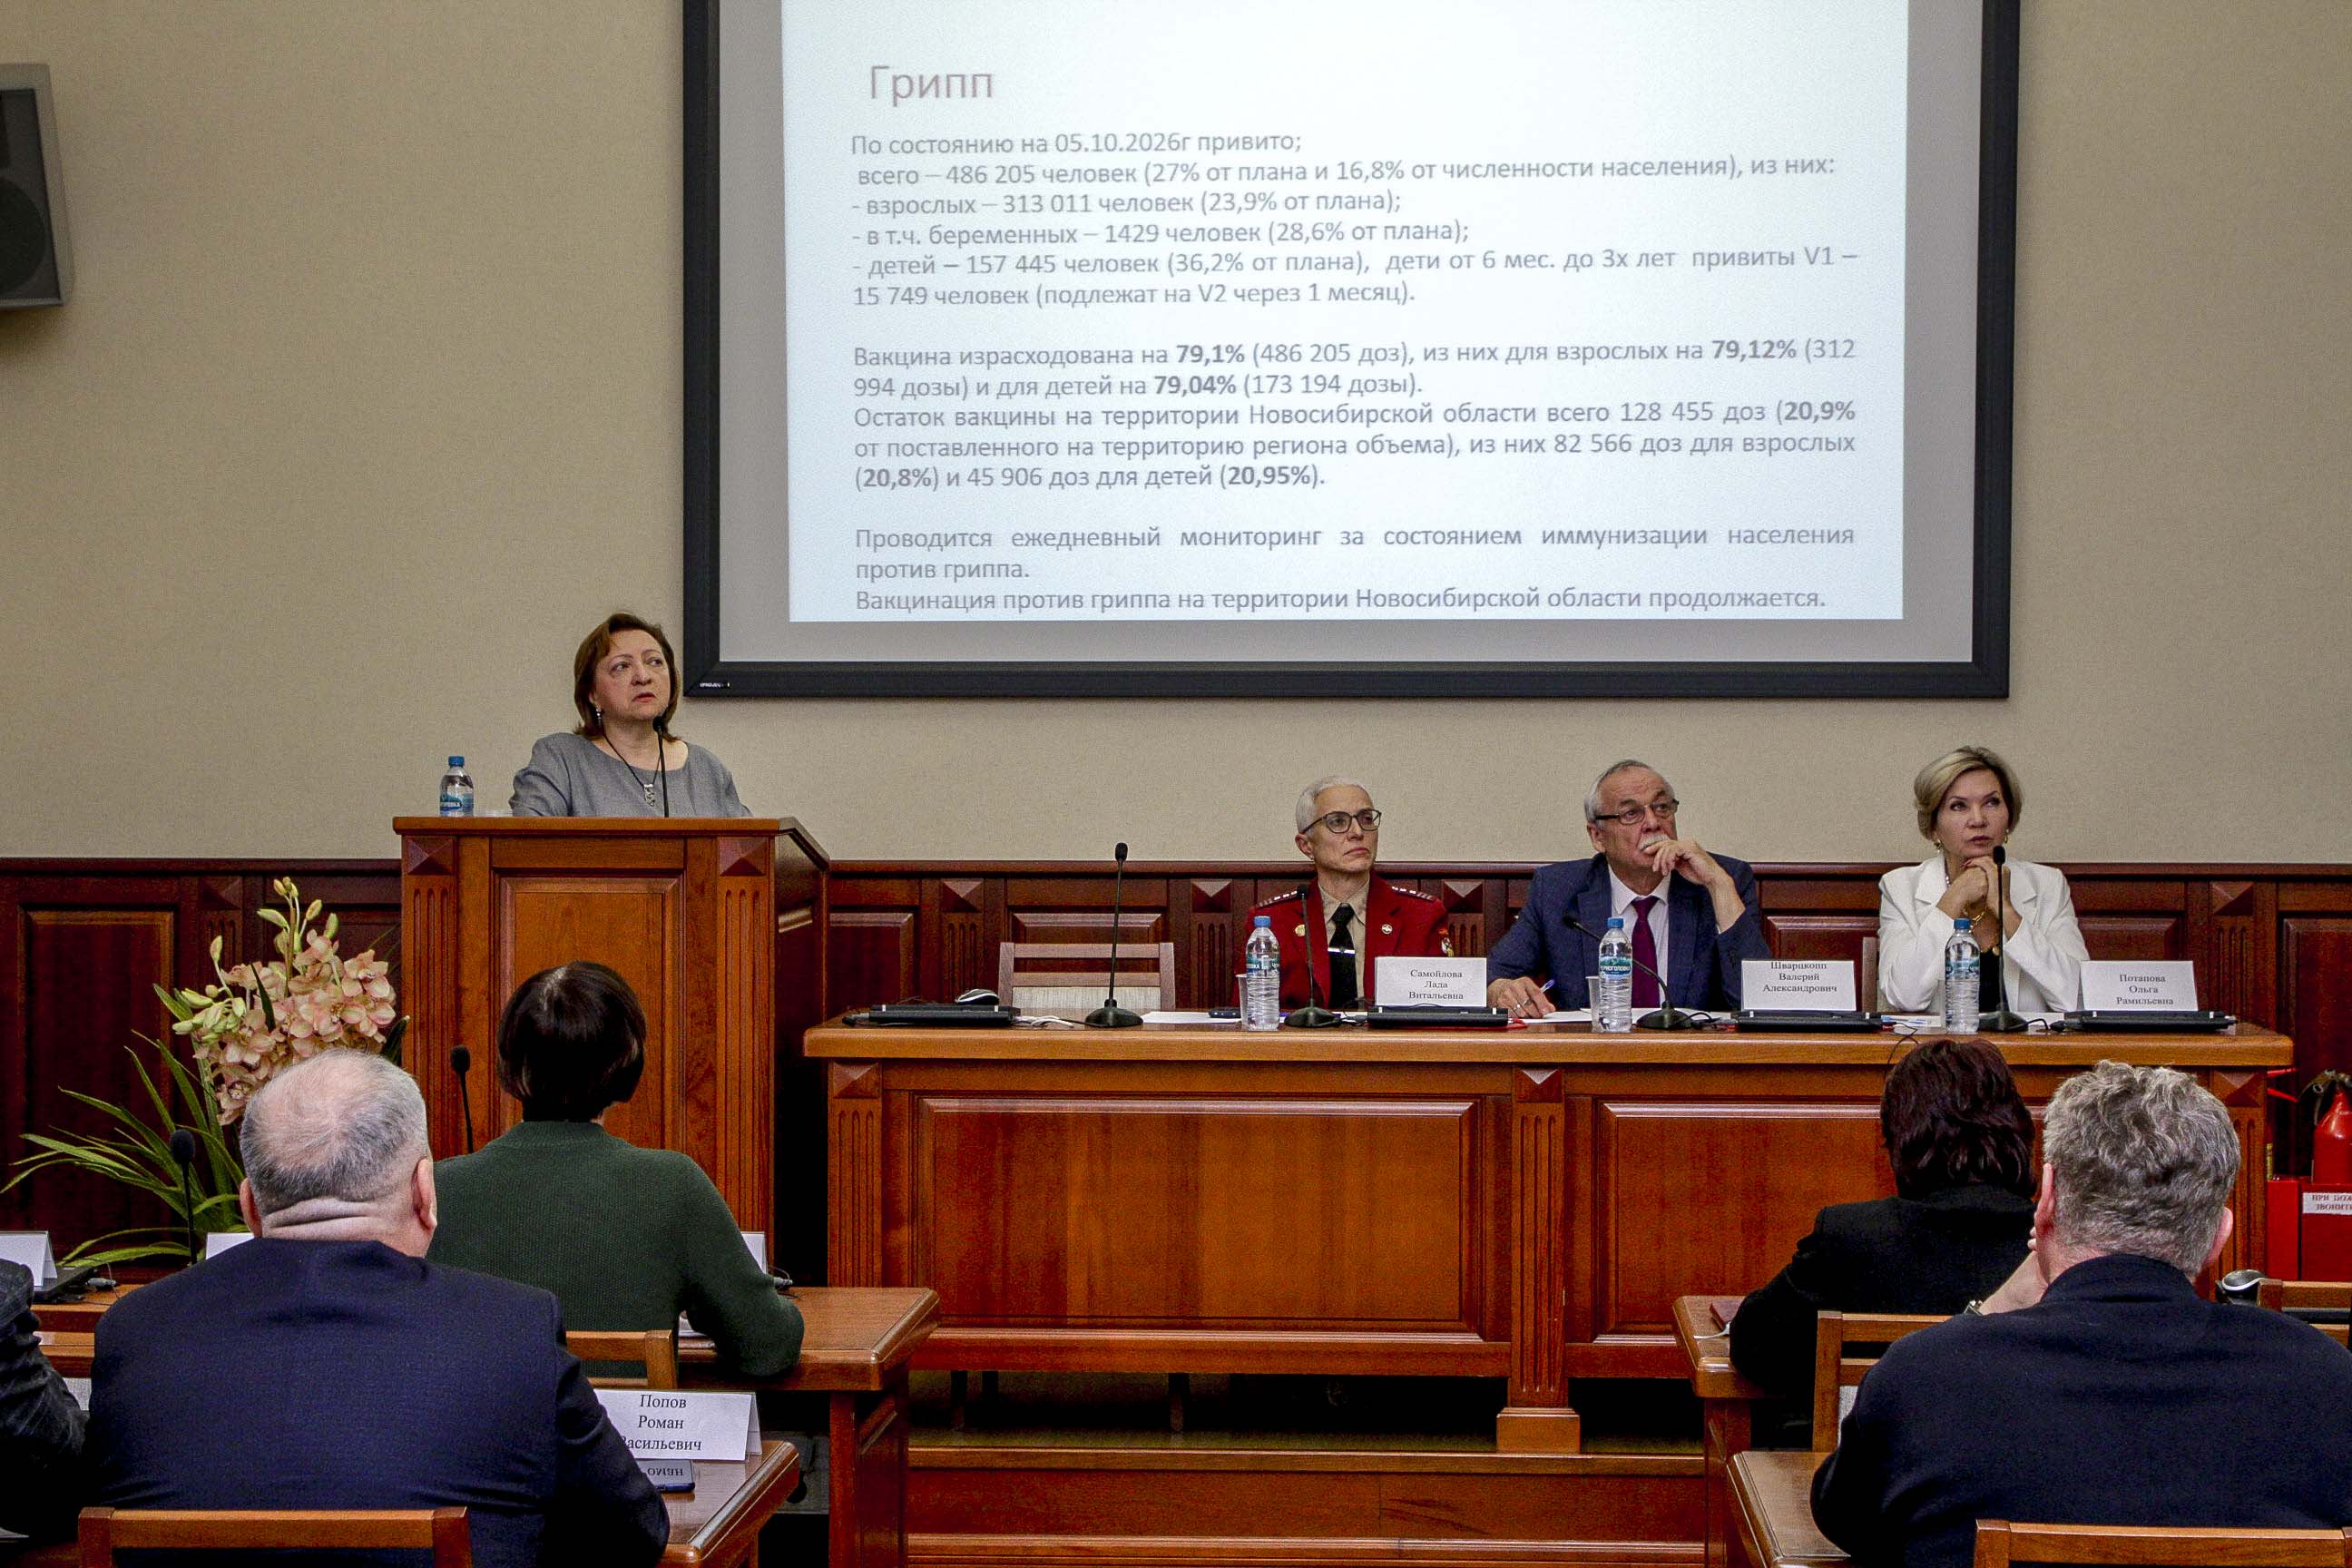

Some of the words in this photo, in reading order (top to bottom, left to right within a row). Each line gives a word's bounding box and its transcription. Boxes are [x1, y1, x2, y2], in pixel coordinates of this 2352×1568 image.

[870, 64, 993, 108] Грипп
[851, 134, 883, 155] По
[888, 138, 1014, 155] состоянию
[1021, 137, 1049, 153] на
[1054, 132, 1191, 153] 05.10.2026г
[1197, 134, 1301, 156] привито;
[858, 170, 920, 186] всего
[945, 164, 988, 185] 486
[995, 163, 1036, 185] 205
[1042, 167, 1138, 184] человек
[1143, 162, 1200, 187] (27%
[1206, 166, 1232, 182] от
[1238, 165, 1308, 181] плана
[1315, 165, 1328, 181] и
[1337, 160, 1406, 183] 16,8%
[1411, 163, 1437, 180] от
[1442, 162, 1594, 179] численности
[1601, 153, 1743, 181] населения),
[1750, 159, 1778, 175] из
[1784, 158, 1835, 174] них:
[867, 199, 977, 220] взрослых
[1003, 193, 1044, 214] 313
[1050, 193, 1093, 213] 011
[1098, 196, 1194, 213] человек
[1200, 191, 1278, 216] (23,9%
[1283, 194, 1310, 211] от
[1316, 189, 1401, 214] плана);
[867, 230, 880, 246] в
[885, 230, 922, 246] т.ч.
[928, 223, 1078, 250] беременных
[1105, 223, 1161, 244] 1429
[1165, 226, 1261, 243] человек
[1268, 220, 1346, 246] (28,6%
[1351, 224, 1378, 241] от
[1383, 219, 1469, 244] плана);
[867, 254, 936, 279] детей
[966, 254, 1008, 275] 157
[1014, 254, 1057, 274] 445
[1063, 258, 1160, 273] человек
[1167, 251, 1244, 278] (36,2%
[1251, 256, 1278, 271] от
[1285, 250, 1370, 276] плана),
[1385, 254, 1441, 275] дети
[1448, 254, 1475, 270] от
[1482, 250, 1496, 270] 6
[1504, 253, 1555, 269] мес.
[1563, 252, 1594, 273] до
[1602, 248, 1629, 269] 3х
[1635, 251, 1677, 268] лет
[1691, 250, 1796, 273] привиты
[1803, 246, 1834, 266] V1
[854, 286, 880, 306] 15
[887, 286, 929, 306] 749
[934, 289, 1030, 305] человек
[1035, 283, 1158, 309] (подлежат
[1163, 288, 1191, 303] на
[1197, 283, 1227, 303] V2
[1232, 287, 1301, 308] через
[1308, 282, 1320, 302] 1
[1328, 279, 1416, 306] месяц).
[854, 347, 952, 370] Вакцина
[959, 348, 1134, 371] израсходована
[1141, 348, 1169, 364] на
[1175, 343, 1246, 368] 79,1%
[1252, 342, 1303, 368] (486
[1309, 342, 1351, 363] 205
[1357, 341, 1415, 368] доз),
[1423, 347, 1449, 362] из
[1456, 346, 1499, 361] них
[1504, 346, 1549, 366] для
[1556, 345, 1669, 367] взрослых
[1675, 344, 1704, 360] на
[1710, 338, 1798, 363] 79,12%
[1804, 338, 1856, 364] (312
[853, 377, 897, 397] 994
[900, 375, 969, 402] дозы)
[975, 381, 990, 397] и
[995, 380, 1039, 400] для
[1044, 374, 1112, 400] детей
[1119, 379, 1147, 396] на
[1153, 373, 1238, 398] 79,04%
[1243, 373, 1293, 399] (173
[1300, 373, 1343, 395] 194
[1347, 372, 1423, 398] дозы).
[854, 407, 946, 427] Остаток
[954, 410, 1056, 430] вакцины
[1065, 409, 1093, 426] на
[1101, 408, 1240, 431] территории
[1250, 401, 1434, 429] Новосибирской
[1442, 401, 1537, 424] области
[1546, 406, 1611, 423] всего
[1620, 401, 1662, 423] 128
[1671, 400, 1714, 422] 455
[1721, 405, 1767, 426] доз
[1776, 399, 1857, 426] (20,9%
[854, 442, 880, 458] от
[887, 441, 1060, 458] поставленного
[1066, 440, 1094, 456] на
[1101, 439, 1245, 462] территорию
[1252, 439, 1348, 461] региона
[1355, 433, 1461, 459] объема),
[1469, 438, 1496, 455] из
[1504, 437, 1547, 454] них
[1553, 433, 1583, 454] 82
[1590, 432, 1633, 454] 566
[1639, 436, 1683, 457] доз
[1689, 436, 1734, 456] для
[1742, 436, 1856, 457] взрослых
[855, 466, 939, 493] (20,8%)
[946, 471, 961, 487] и
[966, 466, 995, 487] 45
[1000, 466, 1044, 487] 906
[1047, 470, 1091, 491] доз
[1094, 470, 1139, 491] для
[1143, 464, 1212, 490] детей
[1219, 463, 1326, 491] (20,95%).
[856, 528, 993, 554] Проводится
[1011, 525, 1161, 552] ежедневный
[1180, 530, 1323, 552] мониторинг
[1339, 530, 1365, 546] за
[1383, 529, 1523, 546] состоянием
[1541, 529, 1709, 551] иммунизации
[1728, 528, 1855, 544] населения
[856, 564, 937, 584] против
[944, 563, 1030, 583] гриппа.
[856, 591, 996, 612] Вакцинация
[1003, 593, 1085, 612] против
[1091, 593, 1171, 612] гриппа
[1178, 593, 1205, 609] на
[1210, 593, 1349, 612] территории
[1356, 585, 1541, 612] Новосибирской
[1546, 585, 1642, 608] области
[1649, 592, 1826, 612] продолжается.
[1410, 968, 1463, 978] Самойлова
[1424, 980, 1448, 989] Лада
[1779, 973, 1820, 982] Валерий
[2119, 974, 2166, 983] Потапова
[1408, 991, 1465, 1000] Витальевна
[1762, 985, 1838, 994] Александрович
[2116, 996, 2174, 1004] Рамильевна
[2129, 985, 2159, 994] Ольга
[640, 1394, 687, 1408] Попов
[638, 1415, 684, 1429] Роман
